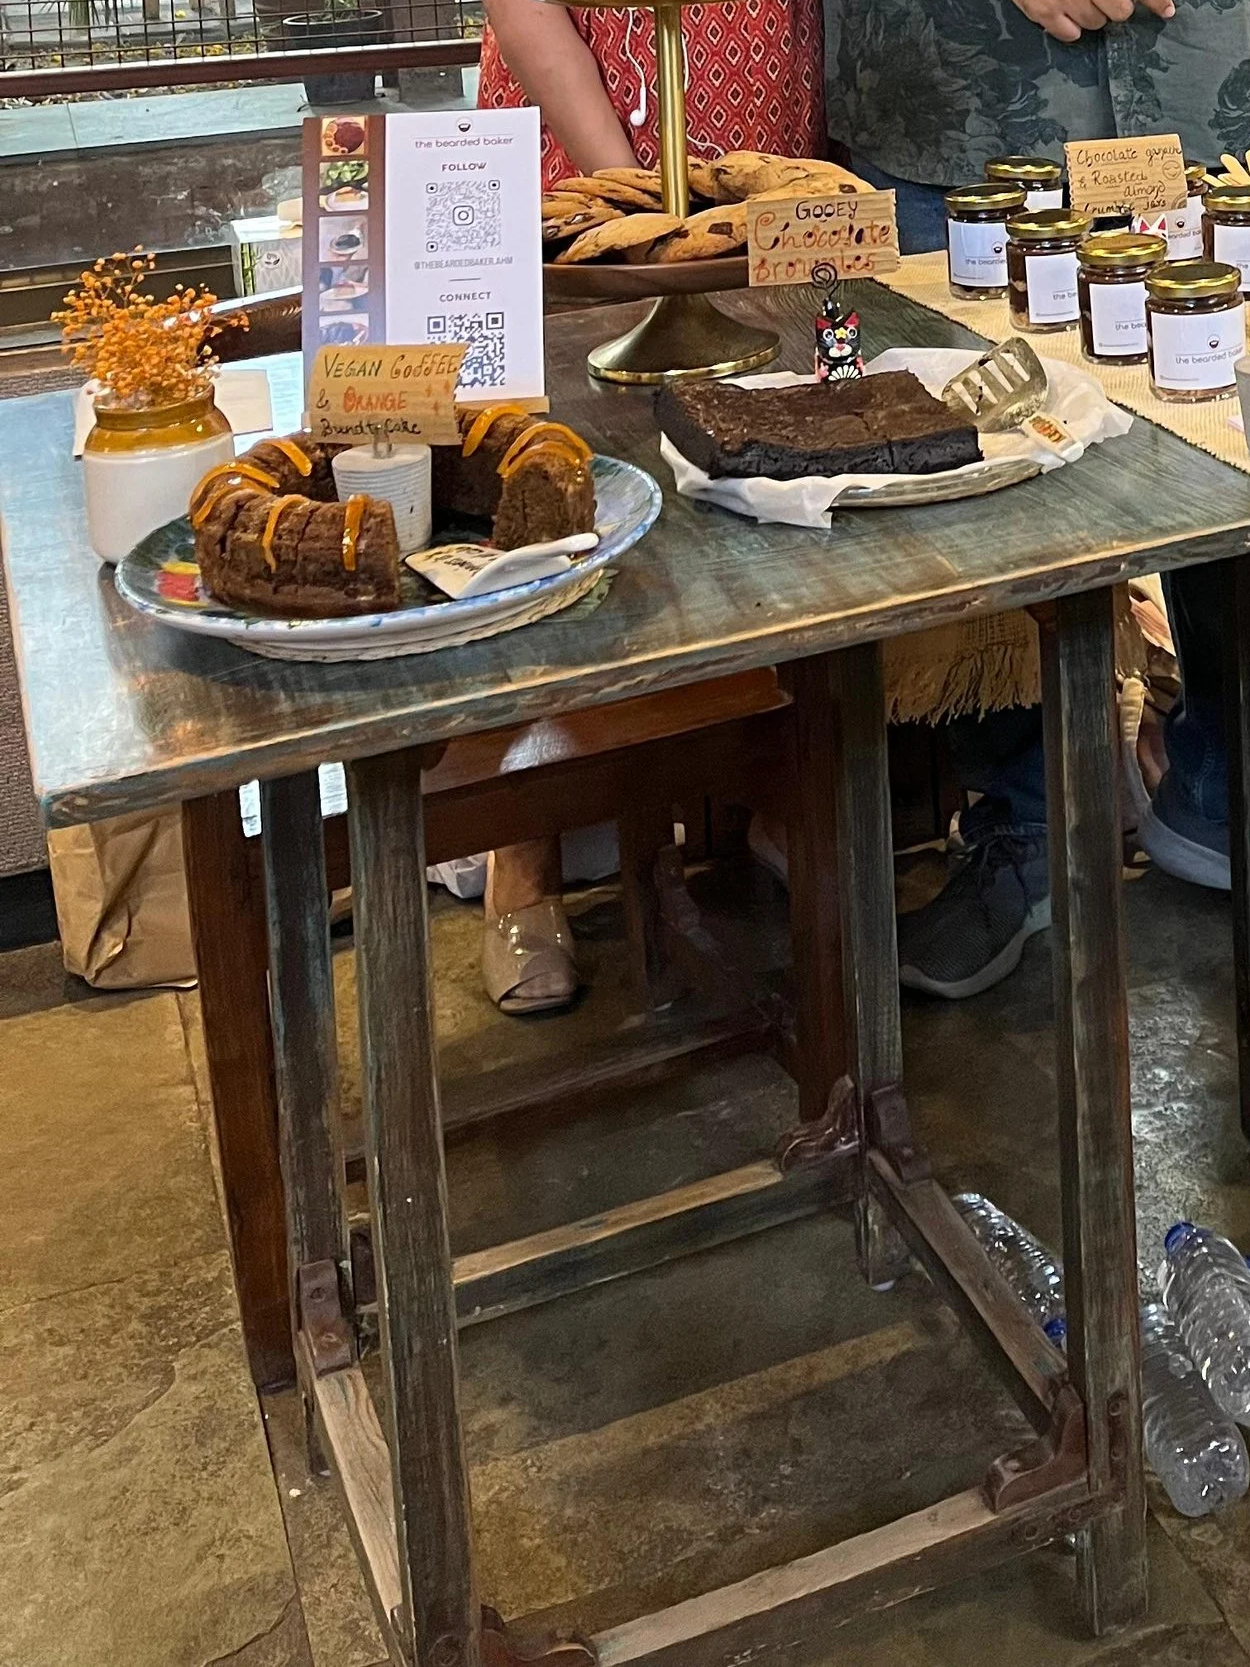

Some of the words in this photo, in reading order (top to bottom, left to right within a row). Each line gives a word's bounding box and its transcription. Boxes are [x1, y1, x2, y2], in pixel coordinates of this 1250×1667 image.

[415, 140, 432, 149] the
[435, 137, 480, 148] bearded
[483, 136, 514, 146] baker
[1077, 147, 1139, 167] Chocolate
[441, 162, 487, 172] FOLLOW
[1091, 169, 1148, 186] Roasted
[795, 200, 858, 221] GOOEY
[753, 211, 891, 251] Chocolate
[965, 258, 977, 266] the
[439, 291, 492, 303] CONNECT
[1115, 322, 1129, 331] the
[324, 352, 383, 379] VEGAN
[1175, 356, 1190, 365] the
[1192, 351, 1227, 365] bearded
[315, 388, 331, 411] &
[320, 417, 372, 438] Bundt
